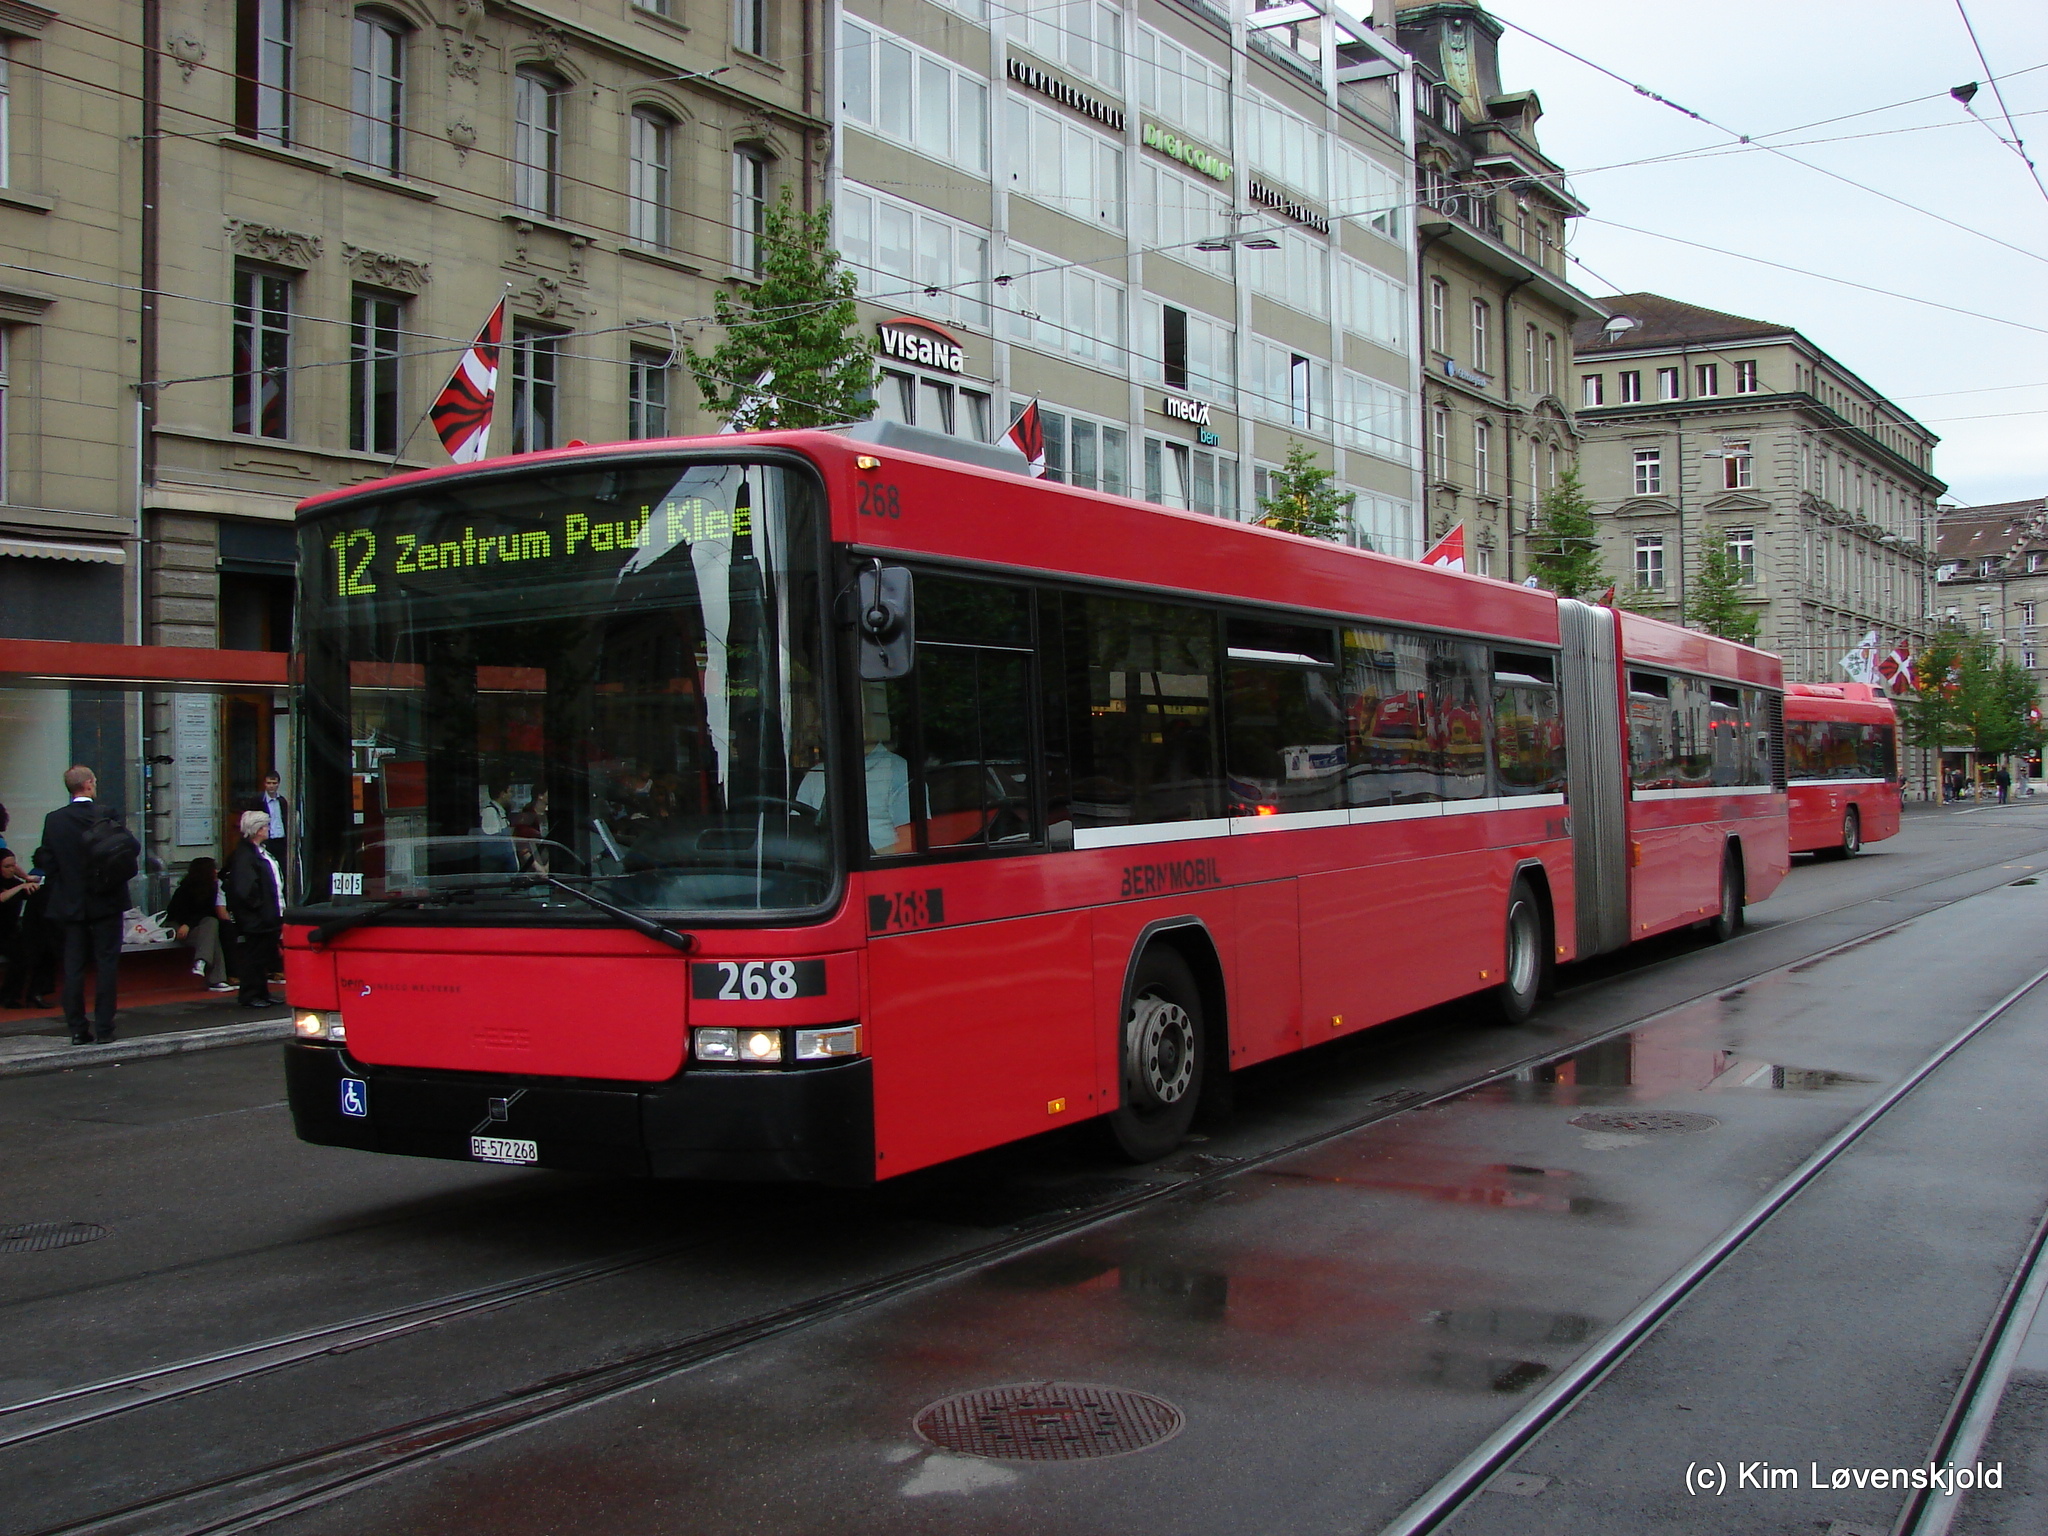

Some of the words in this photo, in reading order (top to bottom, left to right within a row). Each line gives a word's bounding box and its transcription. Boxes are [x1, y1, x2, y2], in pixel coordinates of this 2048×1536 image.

[1008, 57, 1127, 132] COMPUTERSCHULE
[1142, 123, 1231, 182] DIGICOMP
[859, 480, 901, 519] 268
[330, 528, 376, 597] 12
[395, 527, 551, 574] Zentrum
[566, 505, 650, 555] Paul
[667, 499, 752, 543] Klee
[1170, 858, 1221, 889] MOBIL
[885, 890, 930, 928] 268
[718, 960, 797, 1000] 268
